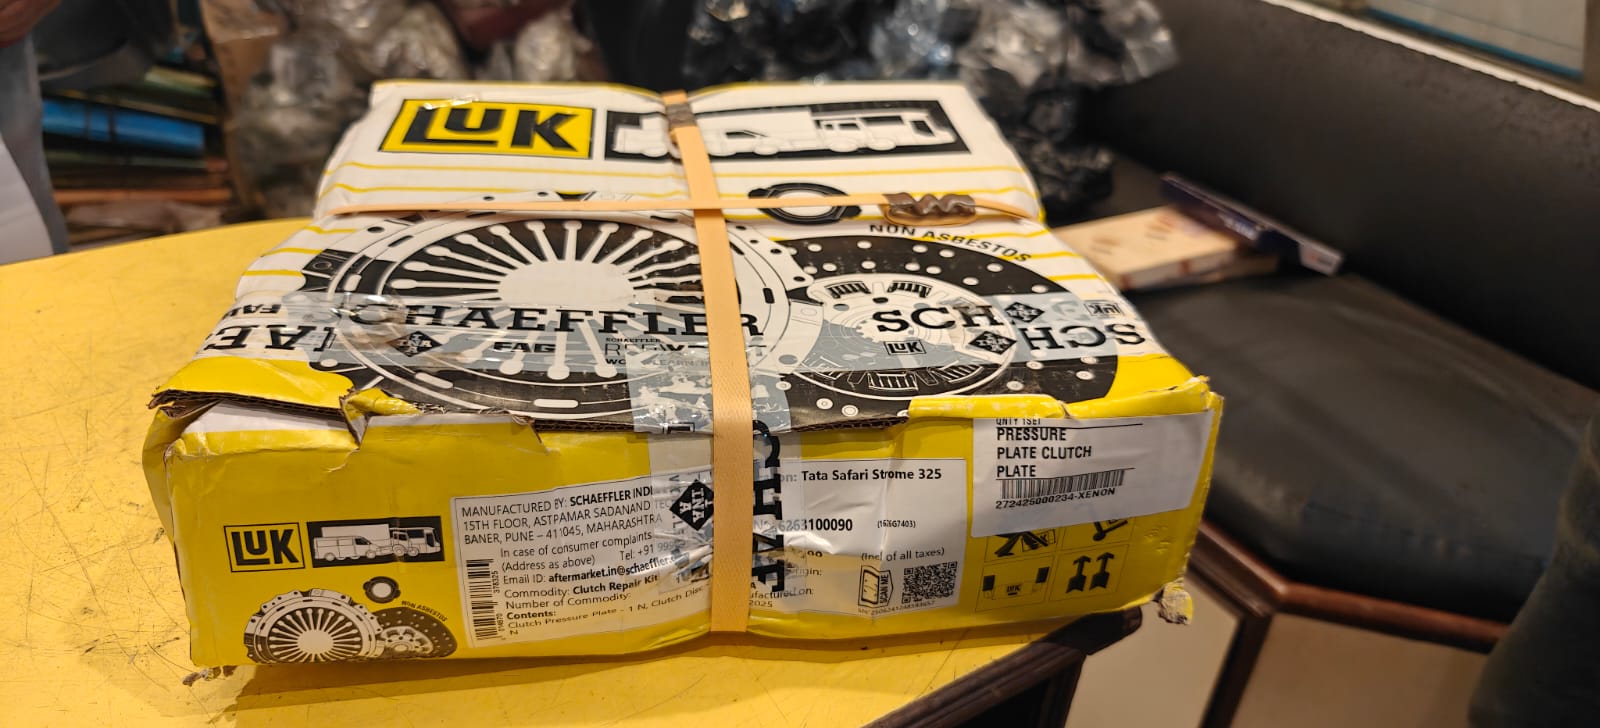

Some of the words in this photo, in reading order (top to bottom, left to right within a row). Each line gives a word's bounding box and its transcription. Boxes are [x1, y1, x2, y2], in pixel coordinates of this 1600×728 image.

[870, 224, 915, 235] NON
[922, 231, 1032, 262] ASBESTOS
[340, 303, 764, 337] CHAEFFLER
[494, 341, 557, 353] FAG
[997, 427, 1067, 441] PRESSURE
[997, 447, 1037, 459] PLATE
[1042, 446, 1092, 459] CLUTCH
[801, 470, 828, 481] Tata
[832, 469, 869, 481] Safari
[872, 468, 914, 480] Strome
[918, 468, 942, 480] 325
[997, 465, 1037, 477] PLATE
[462, 501, 551, 518] MANUFACTURED
[554, 498, 567, 510] BY:
[570, 489, 632, 507] SCHAEFFLER
[633, 485, 654, 499] INDI
[995, 487, 1116, 509] 272425000234-XENON
[464, 520, 490, 531] 15TH
[493, 517, 531, 529] FLOOR,
[593, 500, 651, 518] SADANAND
[464, 532, 503, 545] BANER,
[505, 530, 534, 542] PUNE
[546, 525, 584, 540] 411045,
[586, 511, 663, 533] MAHARASHTRA
[231, 529, 300, 567] LUK
[500, 547, 510, 558] In
[512, 547, 535, 557] case
[538, 544, 548, 555] of
[551, 539, 600, 555] consumer
[602, 531, 653, 548] complaints
[886, 550, 898, 562] of
[900, 549, 912, 561] all
[915, 546, 945, 559] taxes)
[501, 560, 545, 573] (Address
[549, 560, 560, 569] as
[562, 554, 596, 568] above)
[620, 549, 635, 561] Tel:
[637, 543, 655, 557] +91
[503, 573, 530, 585] Email
[533, 572, 547, 583] ID:
[504, 587, 570, 600] Commodity:
[573, 582, 607, 595] Clutch
[609, 578, 642, 592] Repair
[645, 574, 659, 585] Kit
[506, 599, 549, 610] Number
[553, 598, 565, 607] of
[568, 592, 632, 606] Commodity:
[508, 619, 543, 629] Clutch
[545, 614, 589, 625] Pressure
[592, 608, 617, 617] Plate
[651, 593, 682, 607] Clutch
[506, 610, 553, 620] Contents:
